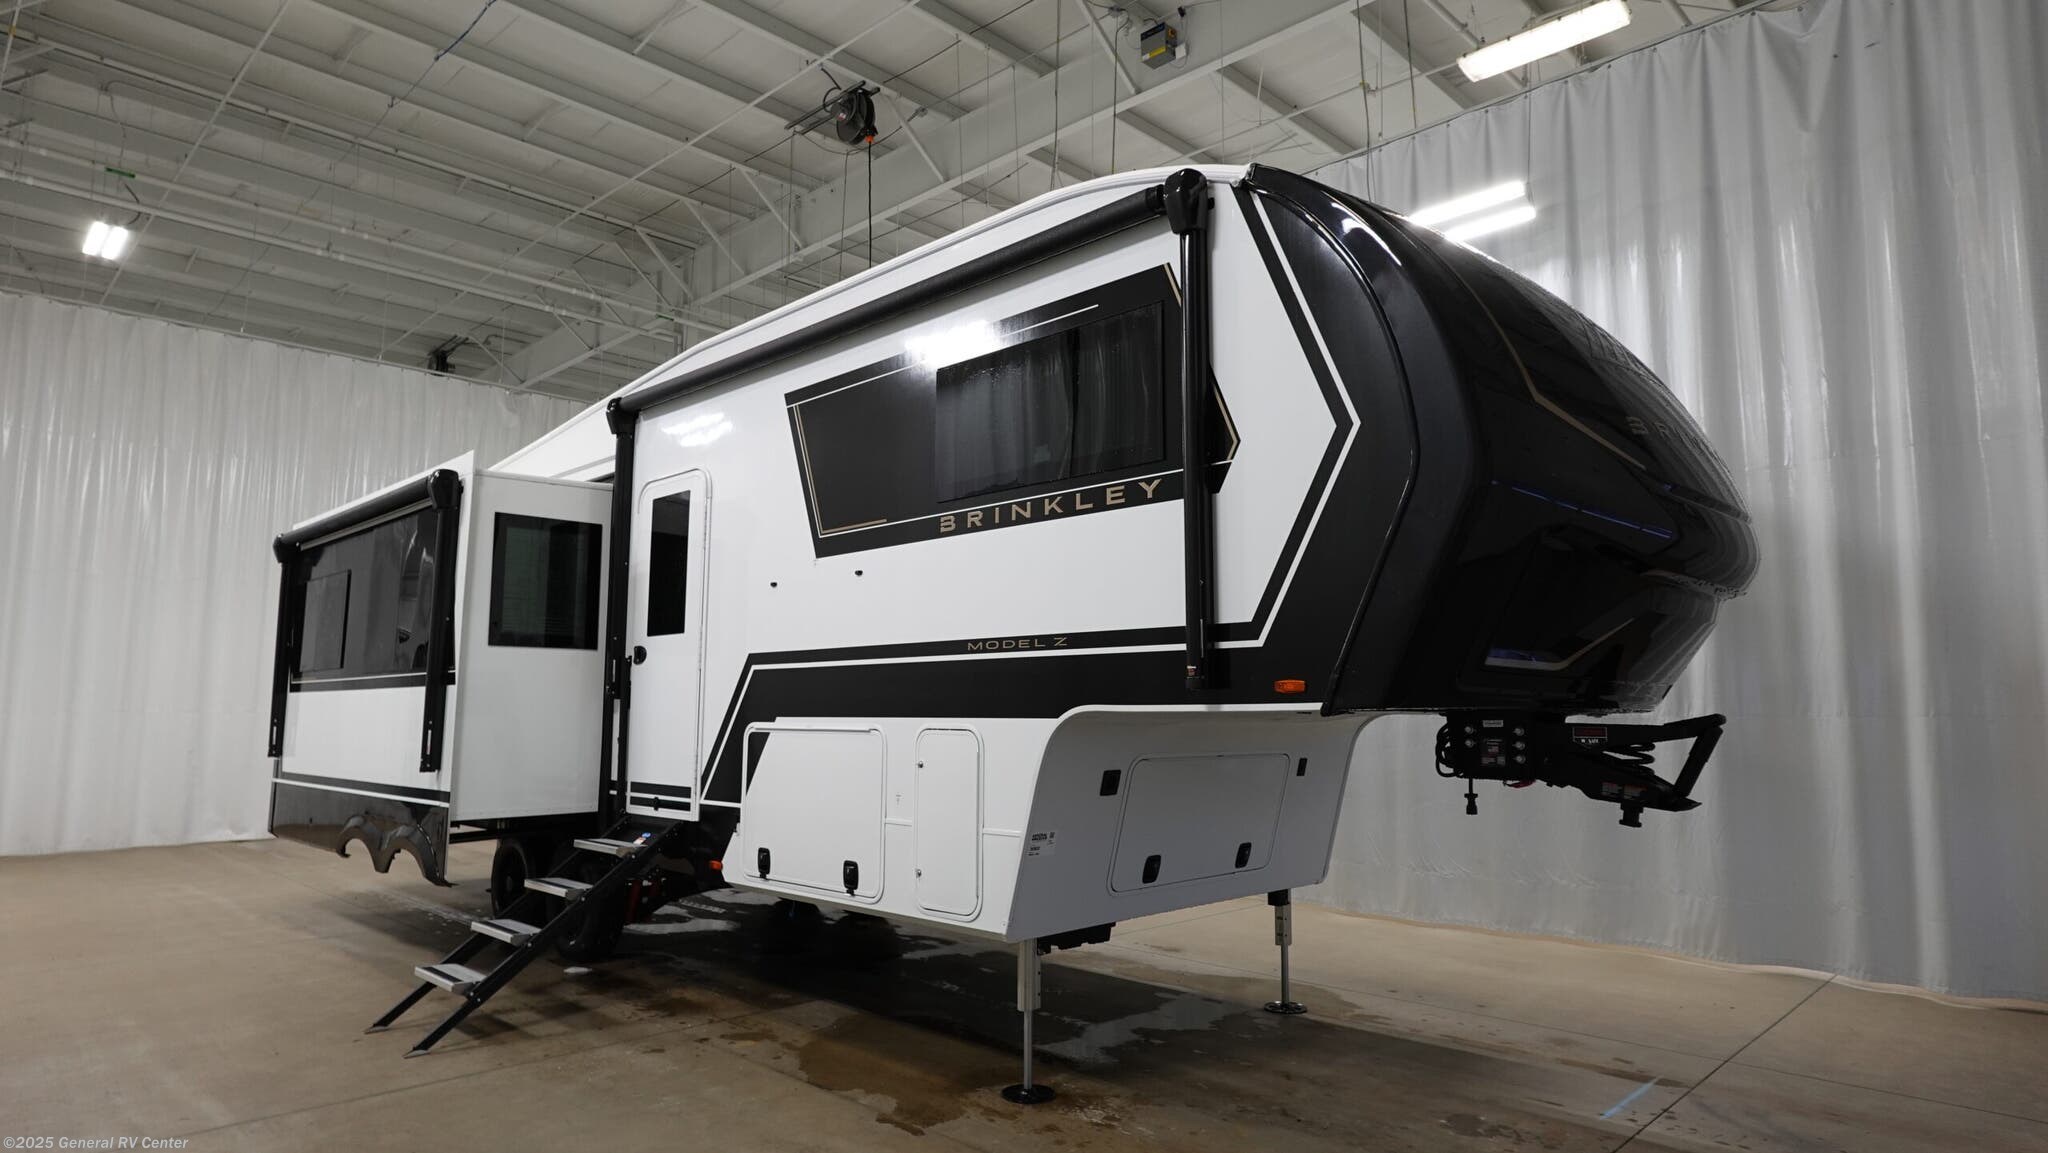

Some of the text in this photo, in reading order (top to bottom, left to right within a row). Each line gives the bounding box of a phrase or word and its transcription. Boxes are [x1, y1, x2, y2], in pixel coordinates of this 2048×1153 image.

[940, 479, 1162, 533] BRINKLEY
[967, 637, 1068, 651] MODEL Z
